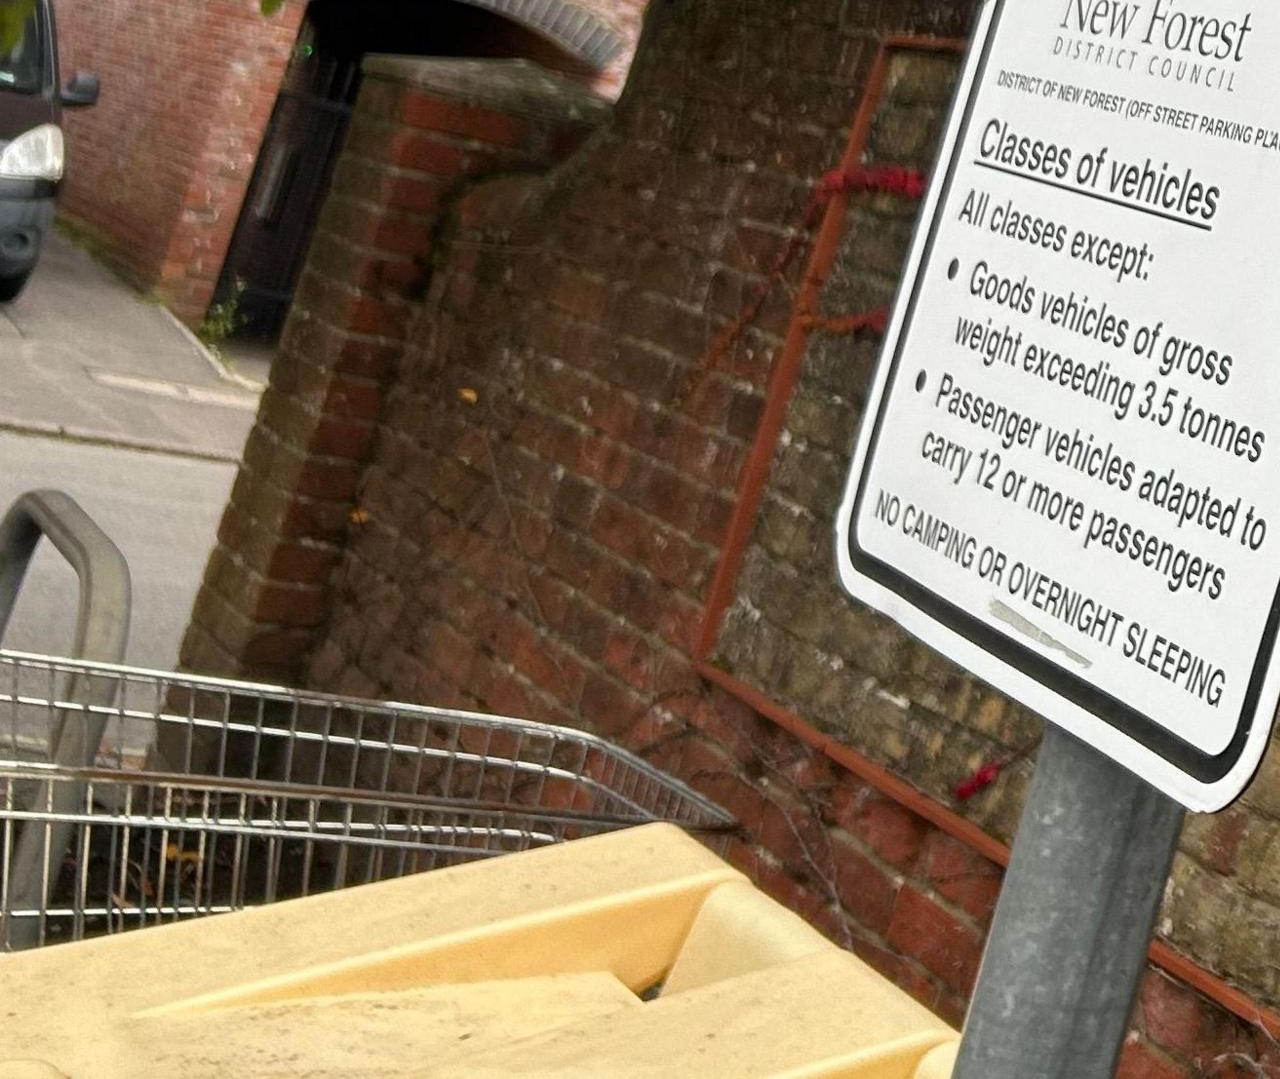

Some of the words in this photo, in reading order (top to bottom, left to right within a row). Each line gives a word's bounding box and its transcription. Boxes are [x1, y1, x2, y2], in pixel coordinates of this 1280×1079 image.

[958, 188, 989, 226] All
[990, 200, 1066, 252] classes
[1071, 231, 1153, 282] except:
[980, 119, 1071, 178] Classes
[1076, 147, 1107, 187] of
[1110, 158, 1219, 219] vehicles
[955, 317, 1021, 366] weight
[1023, 344, 1135, 420] exceeding
[1138, 381, 1178, 426] 3.5
[1179, 396, 1264, 462] tonnes
[970, 260, 1034, 313] Goods
[1040, 292, 1128, 347] vehicles
[1133, 322, 1162, 358] of
[1159, 336, 1232, 385] gross
[922, 432, 972, 484] carry
[976, 448, 1000, 490] 12
[1002, 470, 1026, 501] or
[1027, 481, 1084, 530] more
[1083, 510, 1225, 599] passengers
[935, 373, 1041, 449] Passenger
[1045, 427, 1135, 491] vehicles
[1138, 469, 1241, 537] adapted
[1240, 506, 1266, 550] to
[875, 490, 900, 526] NO
[902, 504, 976, 569] CAMPING
[978, 546, 1006, 586] OR
[1008, 562, 1124, 646] OVERNIGHT
[1122, 622, 1225, 707] SLEEPING
